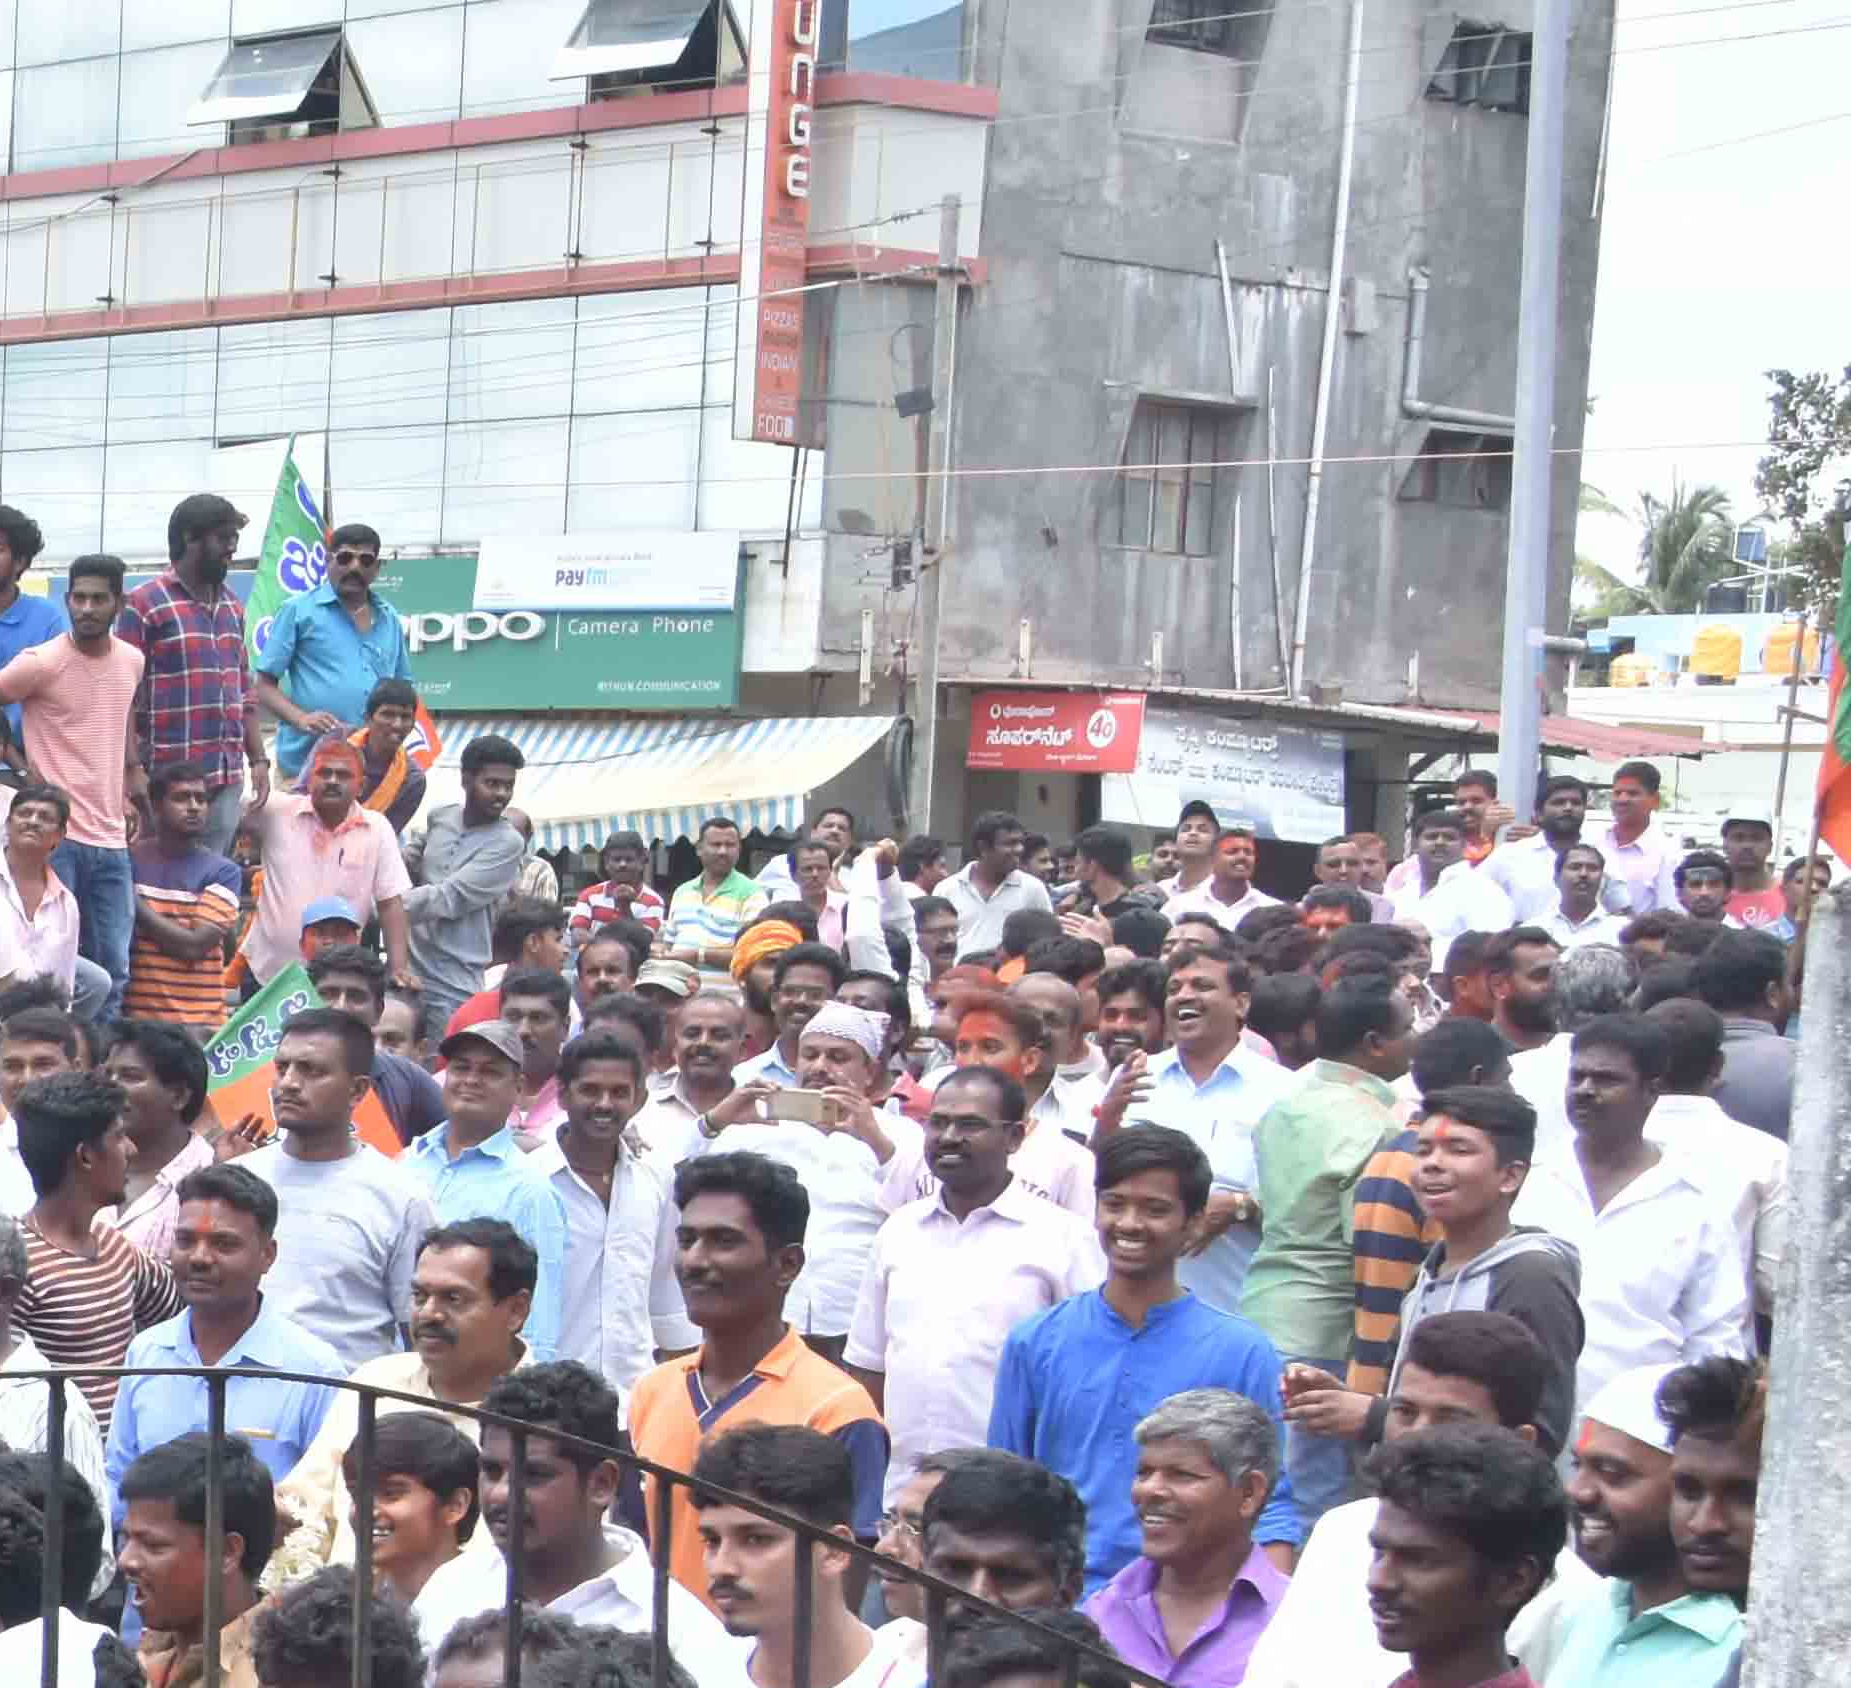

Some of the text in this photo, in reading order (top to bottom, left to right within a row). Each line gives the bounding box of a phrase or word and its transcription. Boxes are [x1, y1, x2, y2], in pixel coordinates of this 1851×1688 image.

[400, 611, 714, 654] ppo Camera Phone
